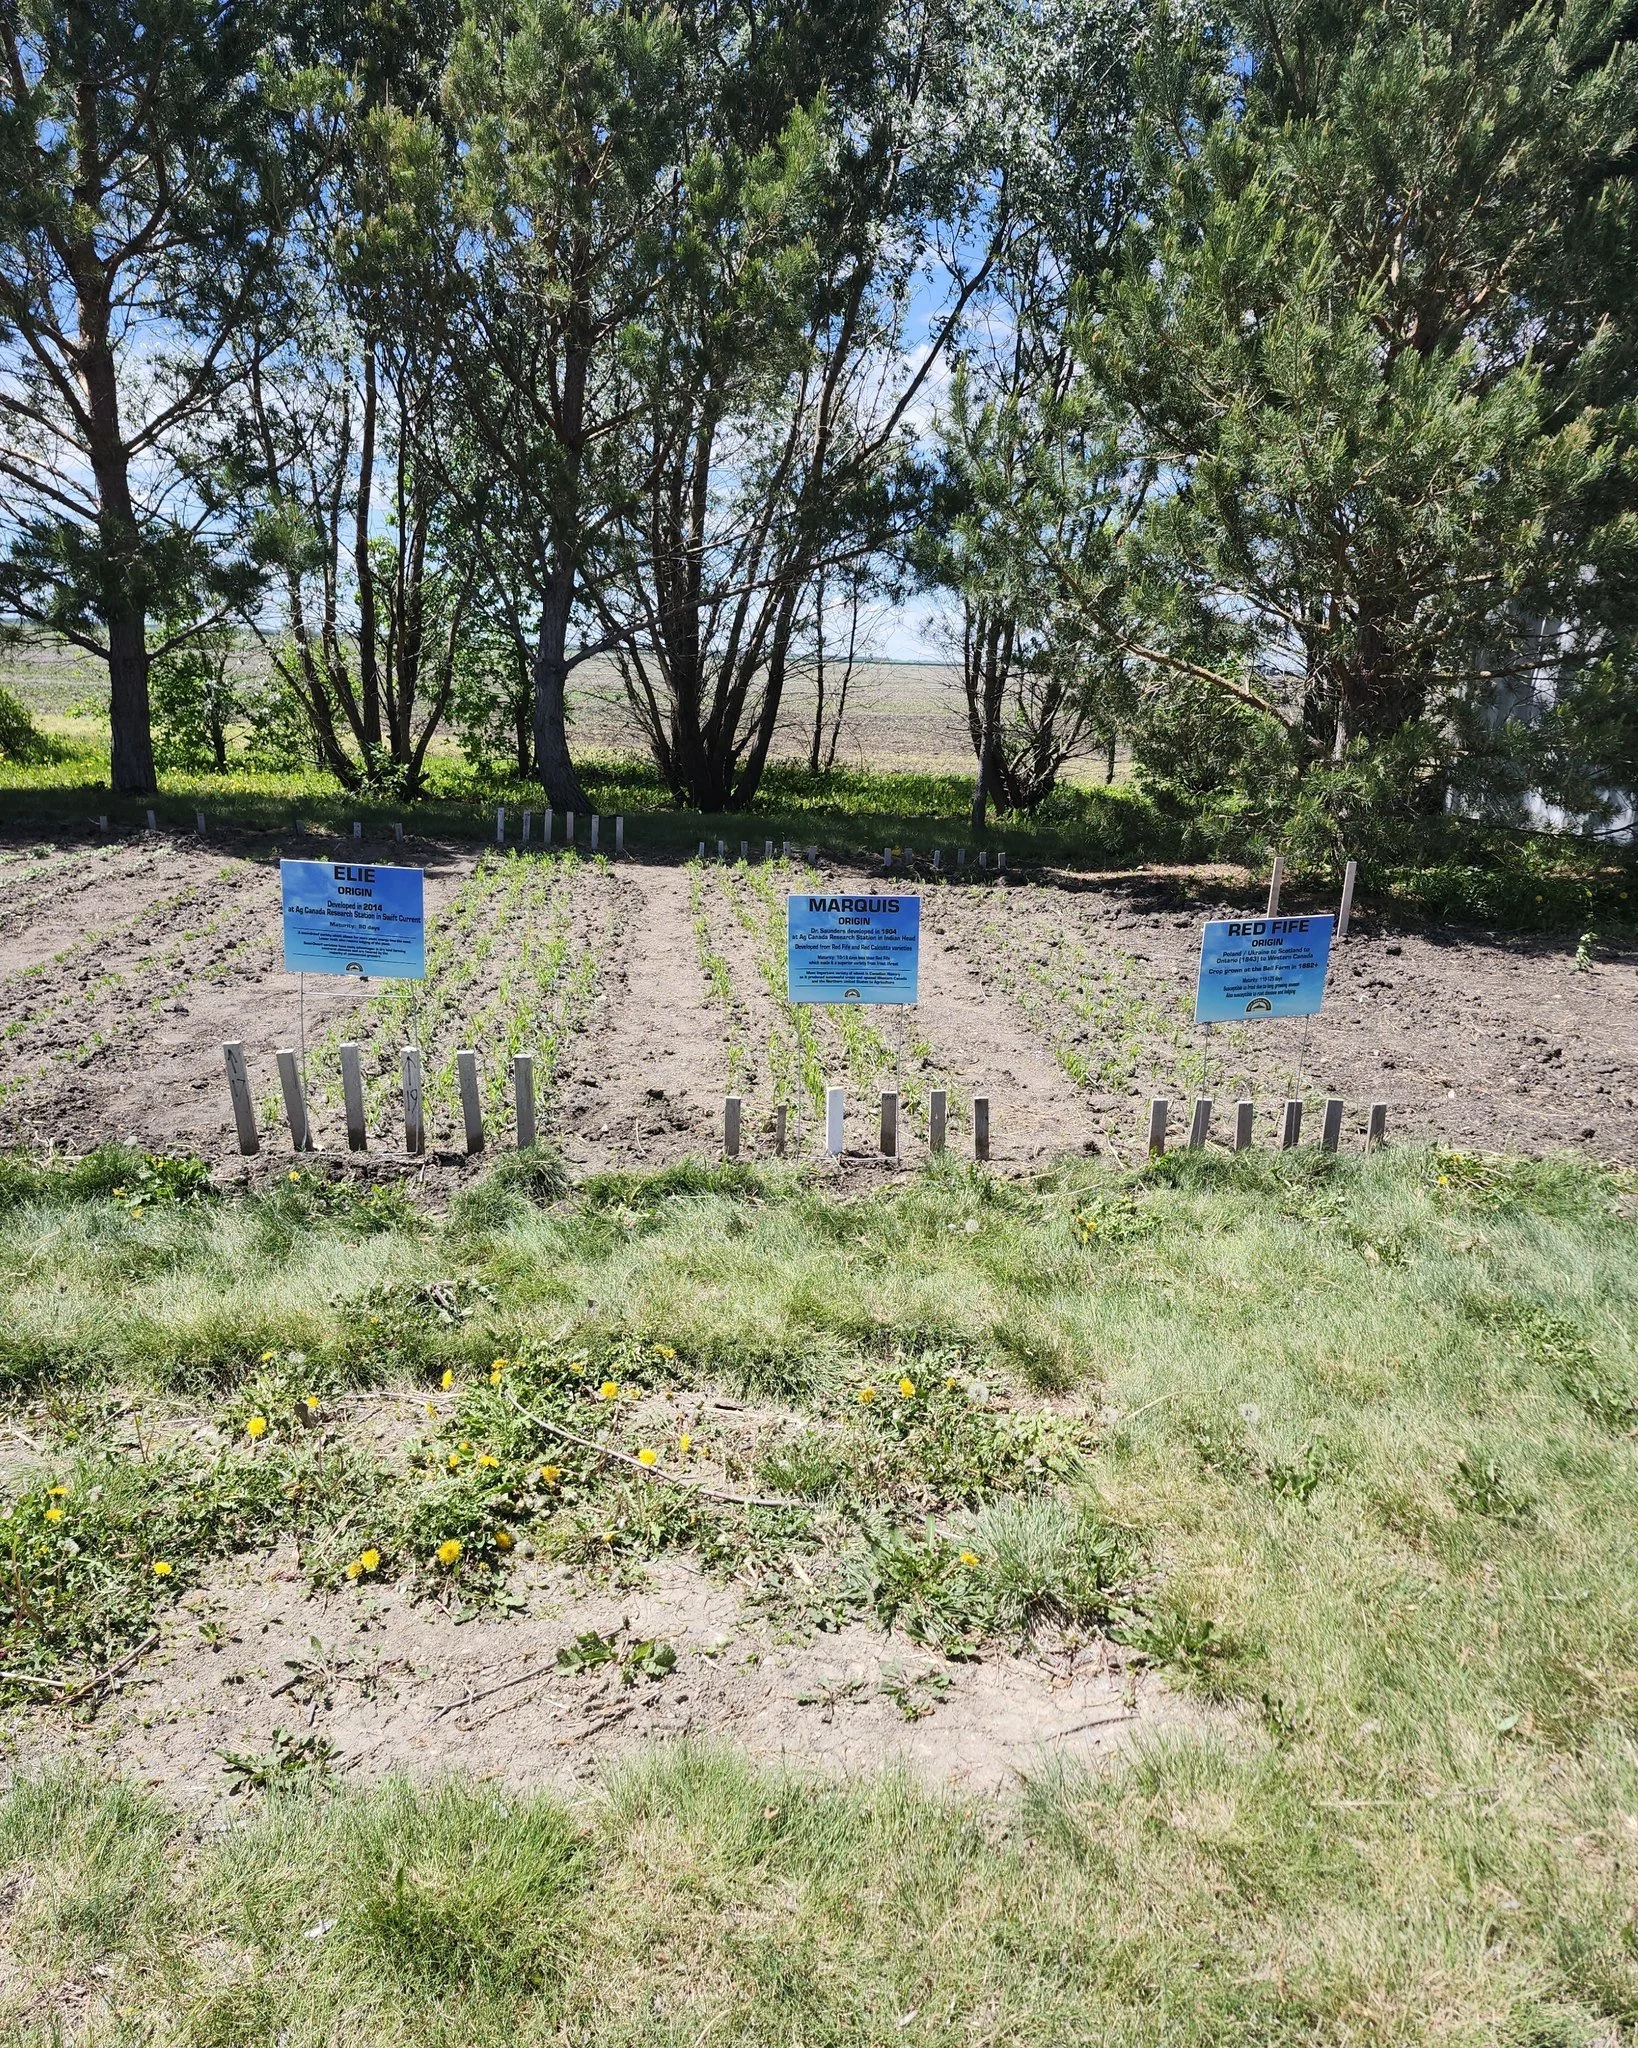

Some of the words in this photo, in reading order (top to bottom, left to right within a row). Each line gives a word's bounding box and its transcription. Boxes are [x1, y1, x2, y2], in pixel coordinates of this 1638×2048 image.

[334, 866, 375, 883] ELIE
[337, 886, 372, 897] ORIGIN
[327, 900, 356, 910] Developed
[363, 903, 382, 912] 2014
[809, 898, 900, 912] MARQUIS
[296, 906, 304, 914] Ag
[304, 907, 326, 915] Canada
[326, 908, 353, 917] Research
[354, 911, 375, 920] Station
[398, 915, 422, 923] Current
[838, 917, 870, 926] ORIGIN
[1228, 922, 1266, 936] RED
[1272, 920, 1310, 934] FIFE
[1252, 938, 1283, 948] ORIGIN
